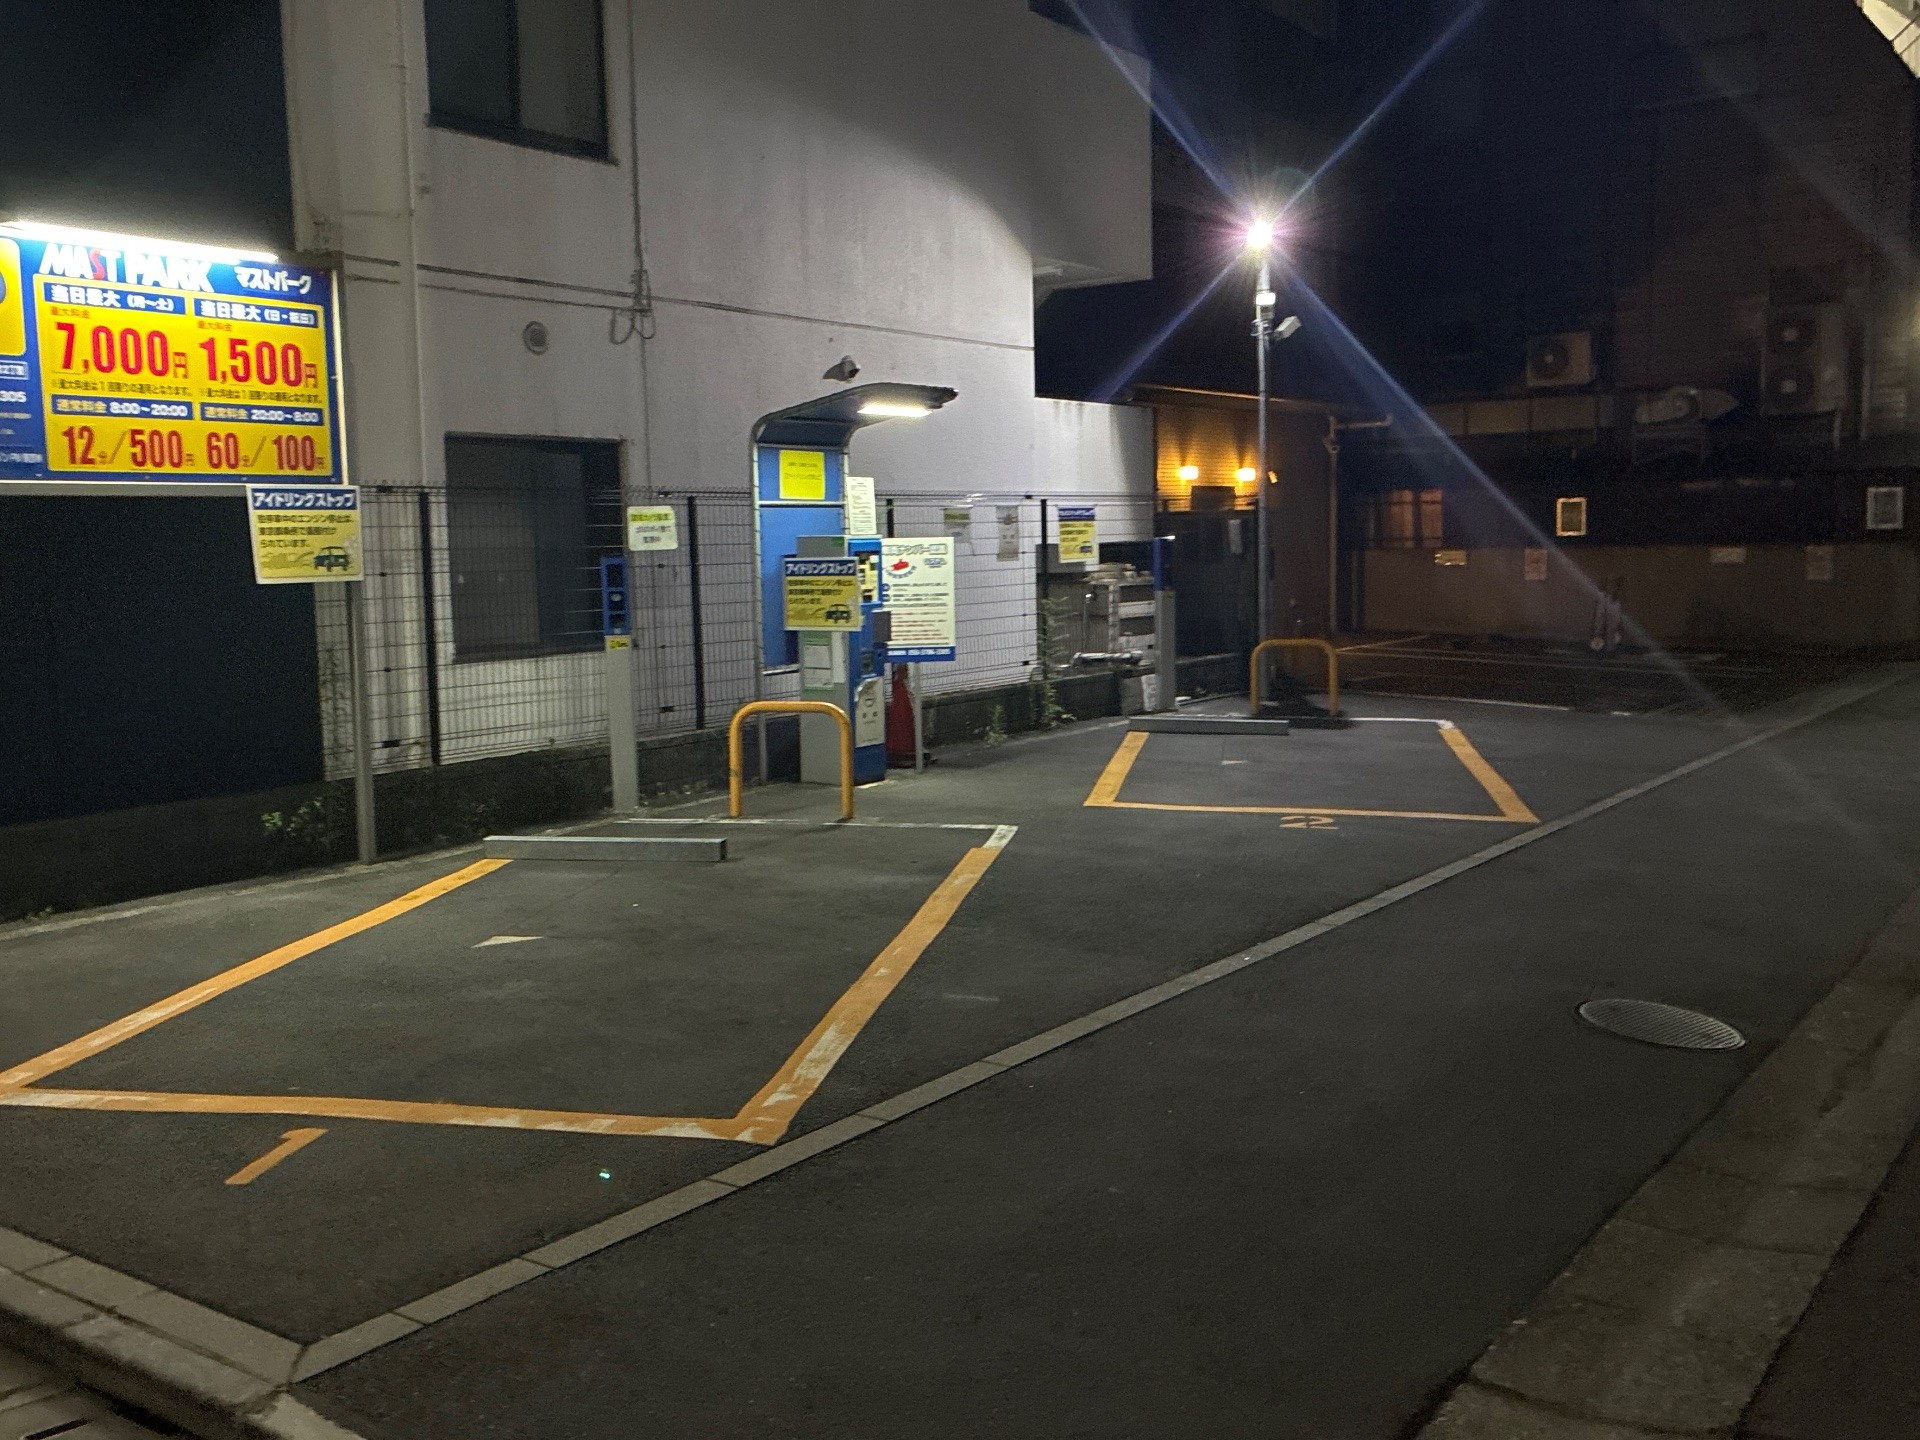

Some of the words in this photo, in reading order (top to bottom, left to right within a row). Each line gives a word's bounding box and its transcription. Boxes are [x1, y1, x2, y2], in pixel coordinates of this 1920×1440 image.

[39, 243, 121, 281] MAST
[124, 251, 214, 293] PARK
[234, 266, 312, 295] マストパーク
[56, 321, 190, 380] 7,000円
[199, 336, 319, 389] 1,500円
[253, 491, 355, 508] アイドリングストップ
[785, 562, 855, 575] アイドリングストップ
[223, 1126, 330, 1185] 1
